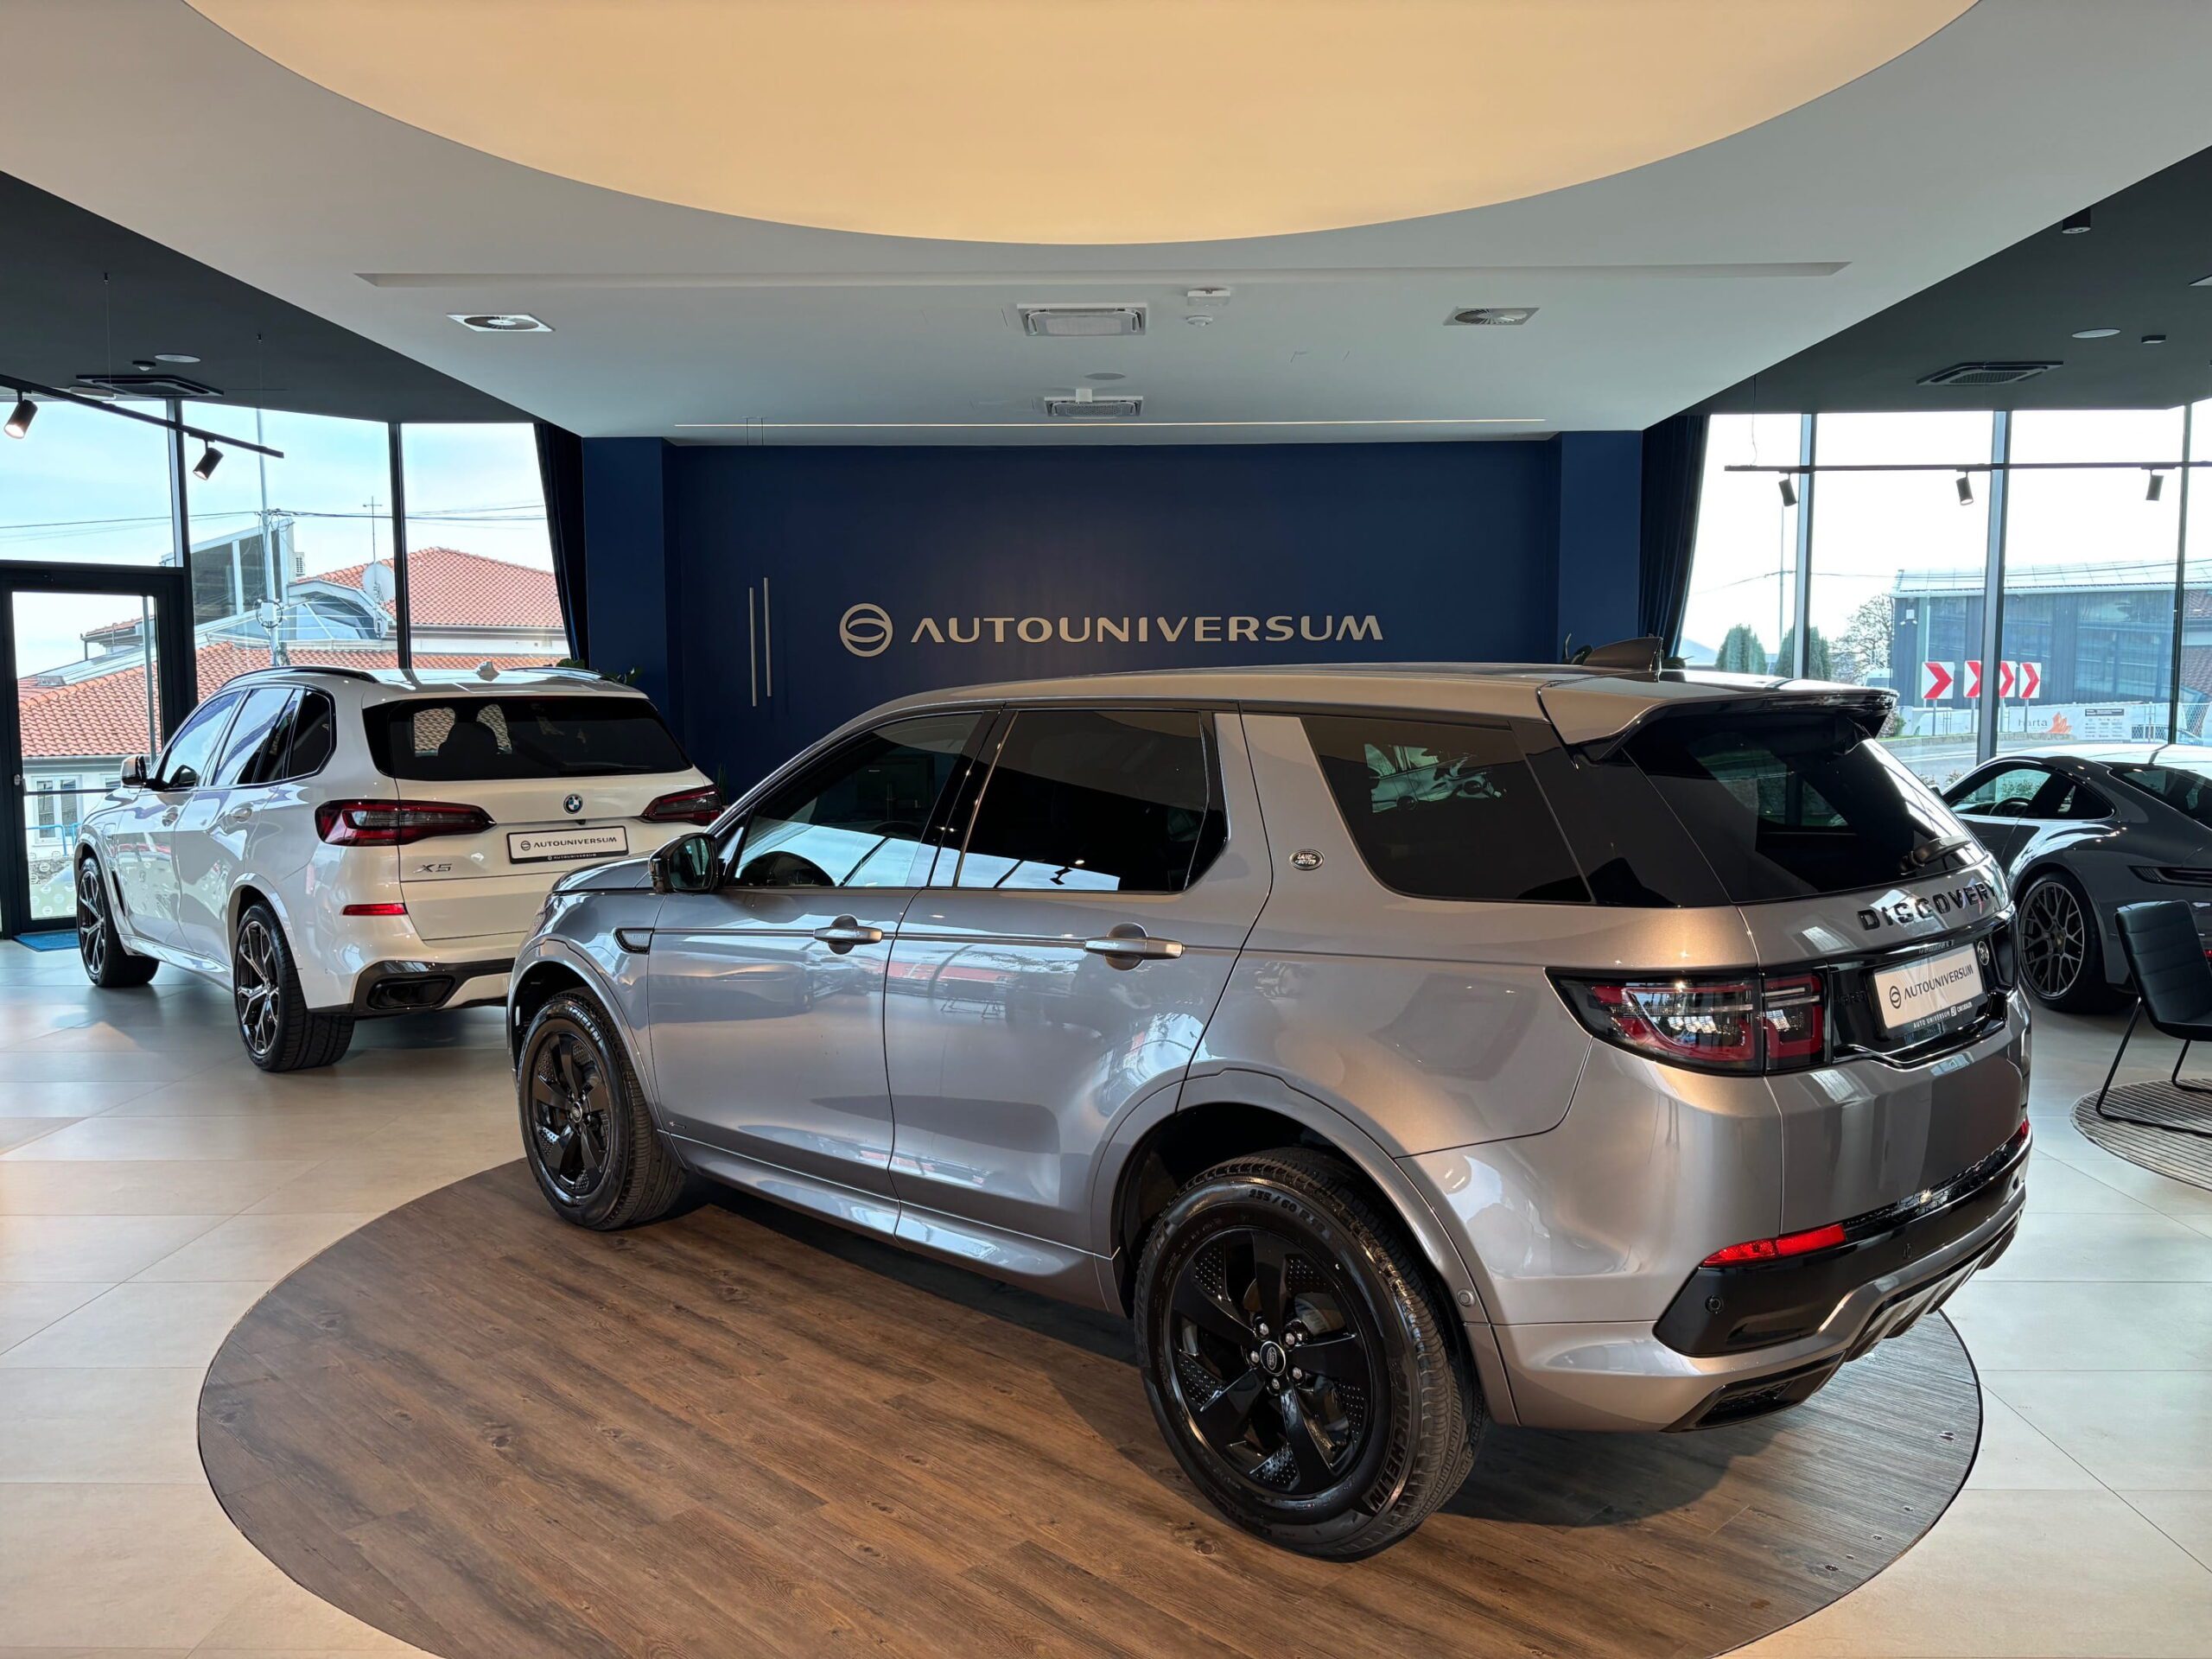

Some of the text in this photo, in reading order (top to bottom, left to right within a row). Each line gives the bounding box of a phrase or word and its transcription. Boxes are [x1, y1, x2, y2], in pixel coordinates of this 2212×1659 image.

[911, 614, 1383, 643] AUTOUNIVERSUM
[533, 836, 617, 849] AUTOUNIVERSUM
[414, 864, 452, 873] X5
[1857, 880, 1996, 931] DISCOVERY
[1904, 964, 1974, 1001] AUTOUNIVERSUM
[1913, 1020, 1926, 1029] AUTO
[1369, 1393, 1410, 1511] MICHELIN
